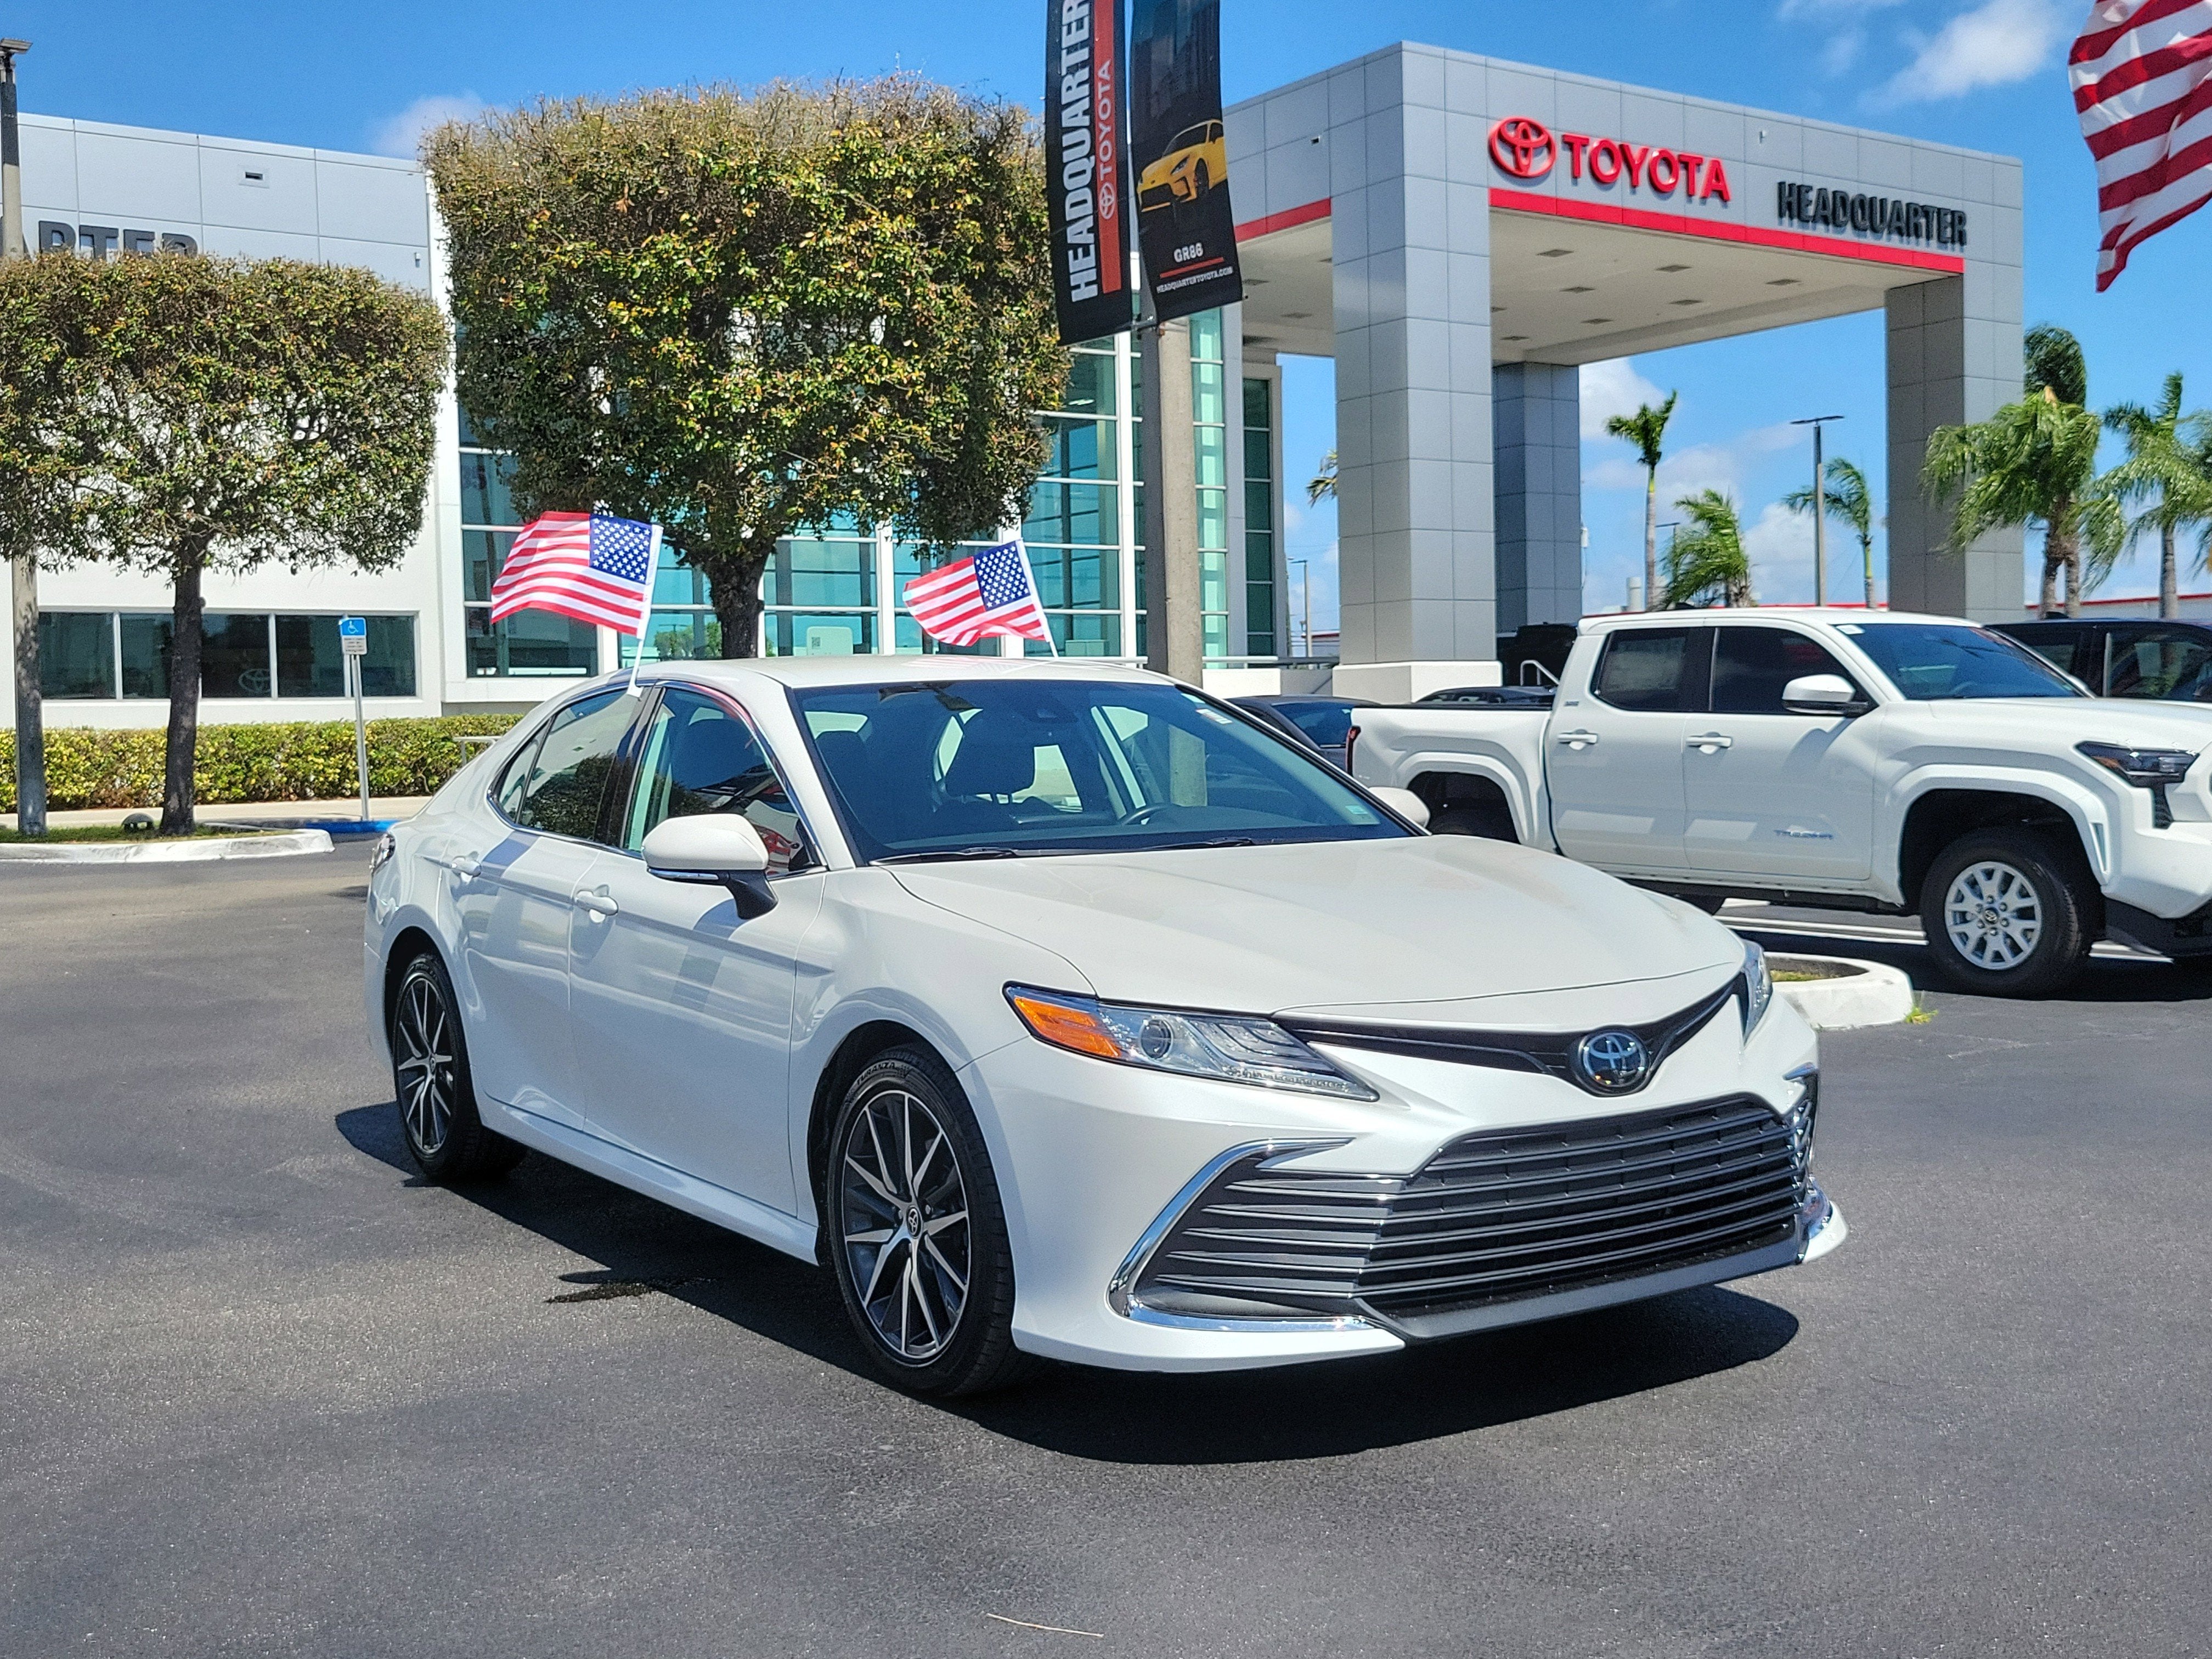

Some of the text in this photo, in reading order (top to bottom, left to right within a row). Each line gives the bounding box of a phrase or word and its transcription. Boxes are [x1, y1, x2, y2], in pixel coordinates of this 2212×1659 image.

[1061, 0, 1098, 302] HEADQUARTER
[1098, 59, 1113, 179] TOYOTA
[1561, 133, 1731, 202] TOYOTA
[1778, 181, 1967, 246] HEADQUARTER
